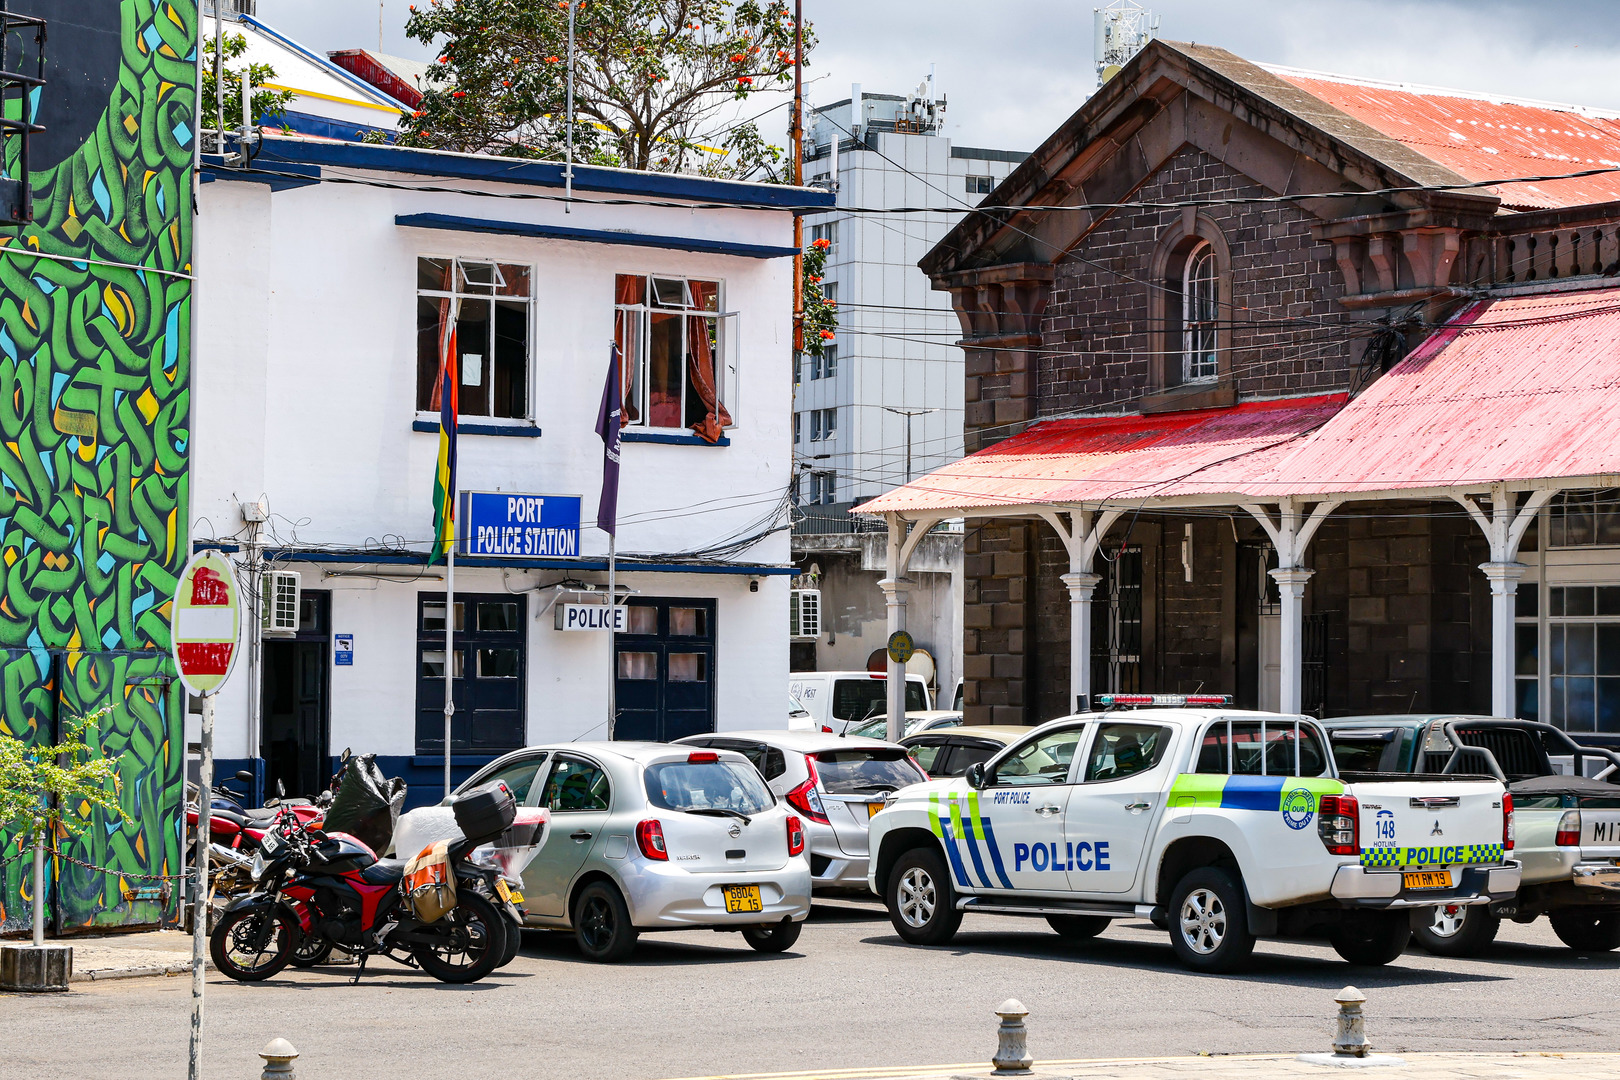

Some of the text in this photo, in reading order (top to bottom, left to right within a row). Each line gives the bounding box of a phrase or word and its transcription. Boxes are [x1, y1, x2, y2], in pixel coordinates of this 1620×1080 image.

[507, 497, 544, 523] PORT
[477, 526, 576, 556] POLICE STATION
[196, 580, 219, 604] NO
[994, 792, 1030, 804] PORT POLICE
[1285, 790, 1298, 807] PUBLIC
[1284, 812, 1312, 829] PRIME DUTY
[1375, 820, 1395, 839] 148
[1014, 841, 1110, 872] POLICE
[1406, 846, 1464, 864] POLICE
[1405, 874, 1421, 886] 171
[1435, 873, 1446, 885] 19
[730, 887, 753, 899] 6804
[730, 899, 759, 911] EZ 15
